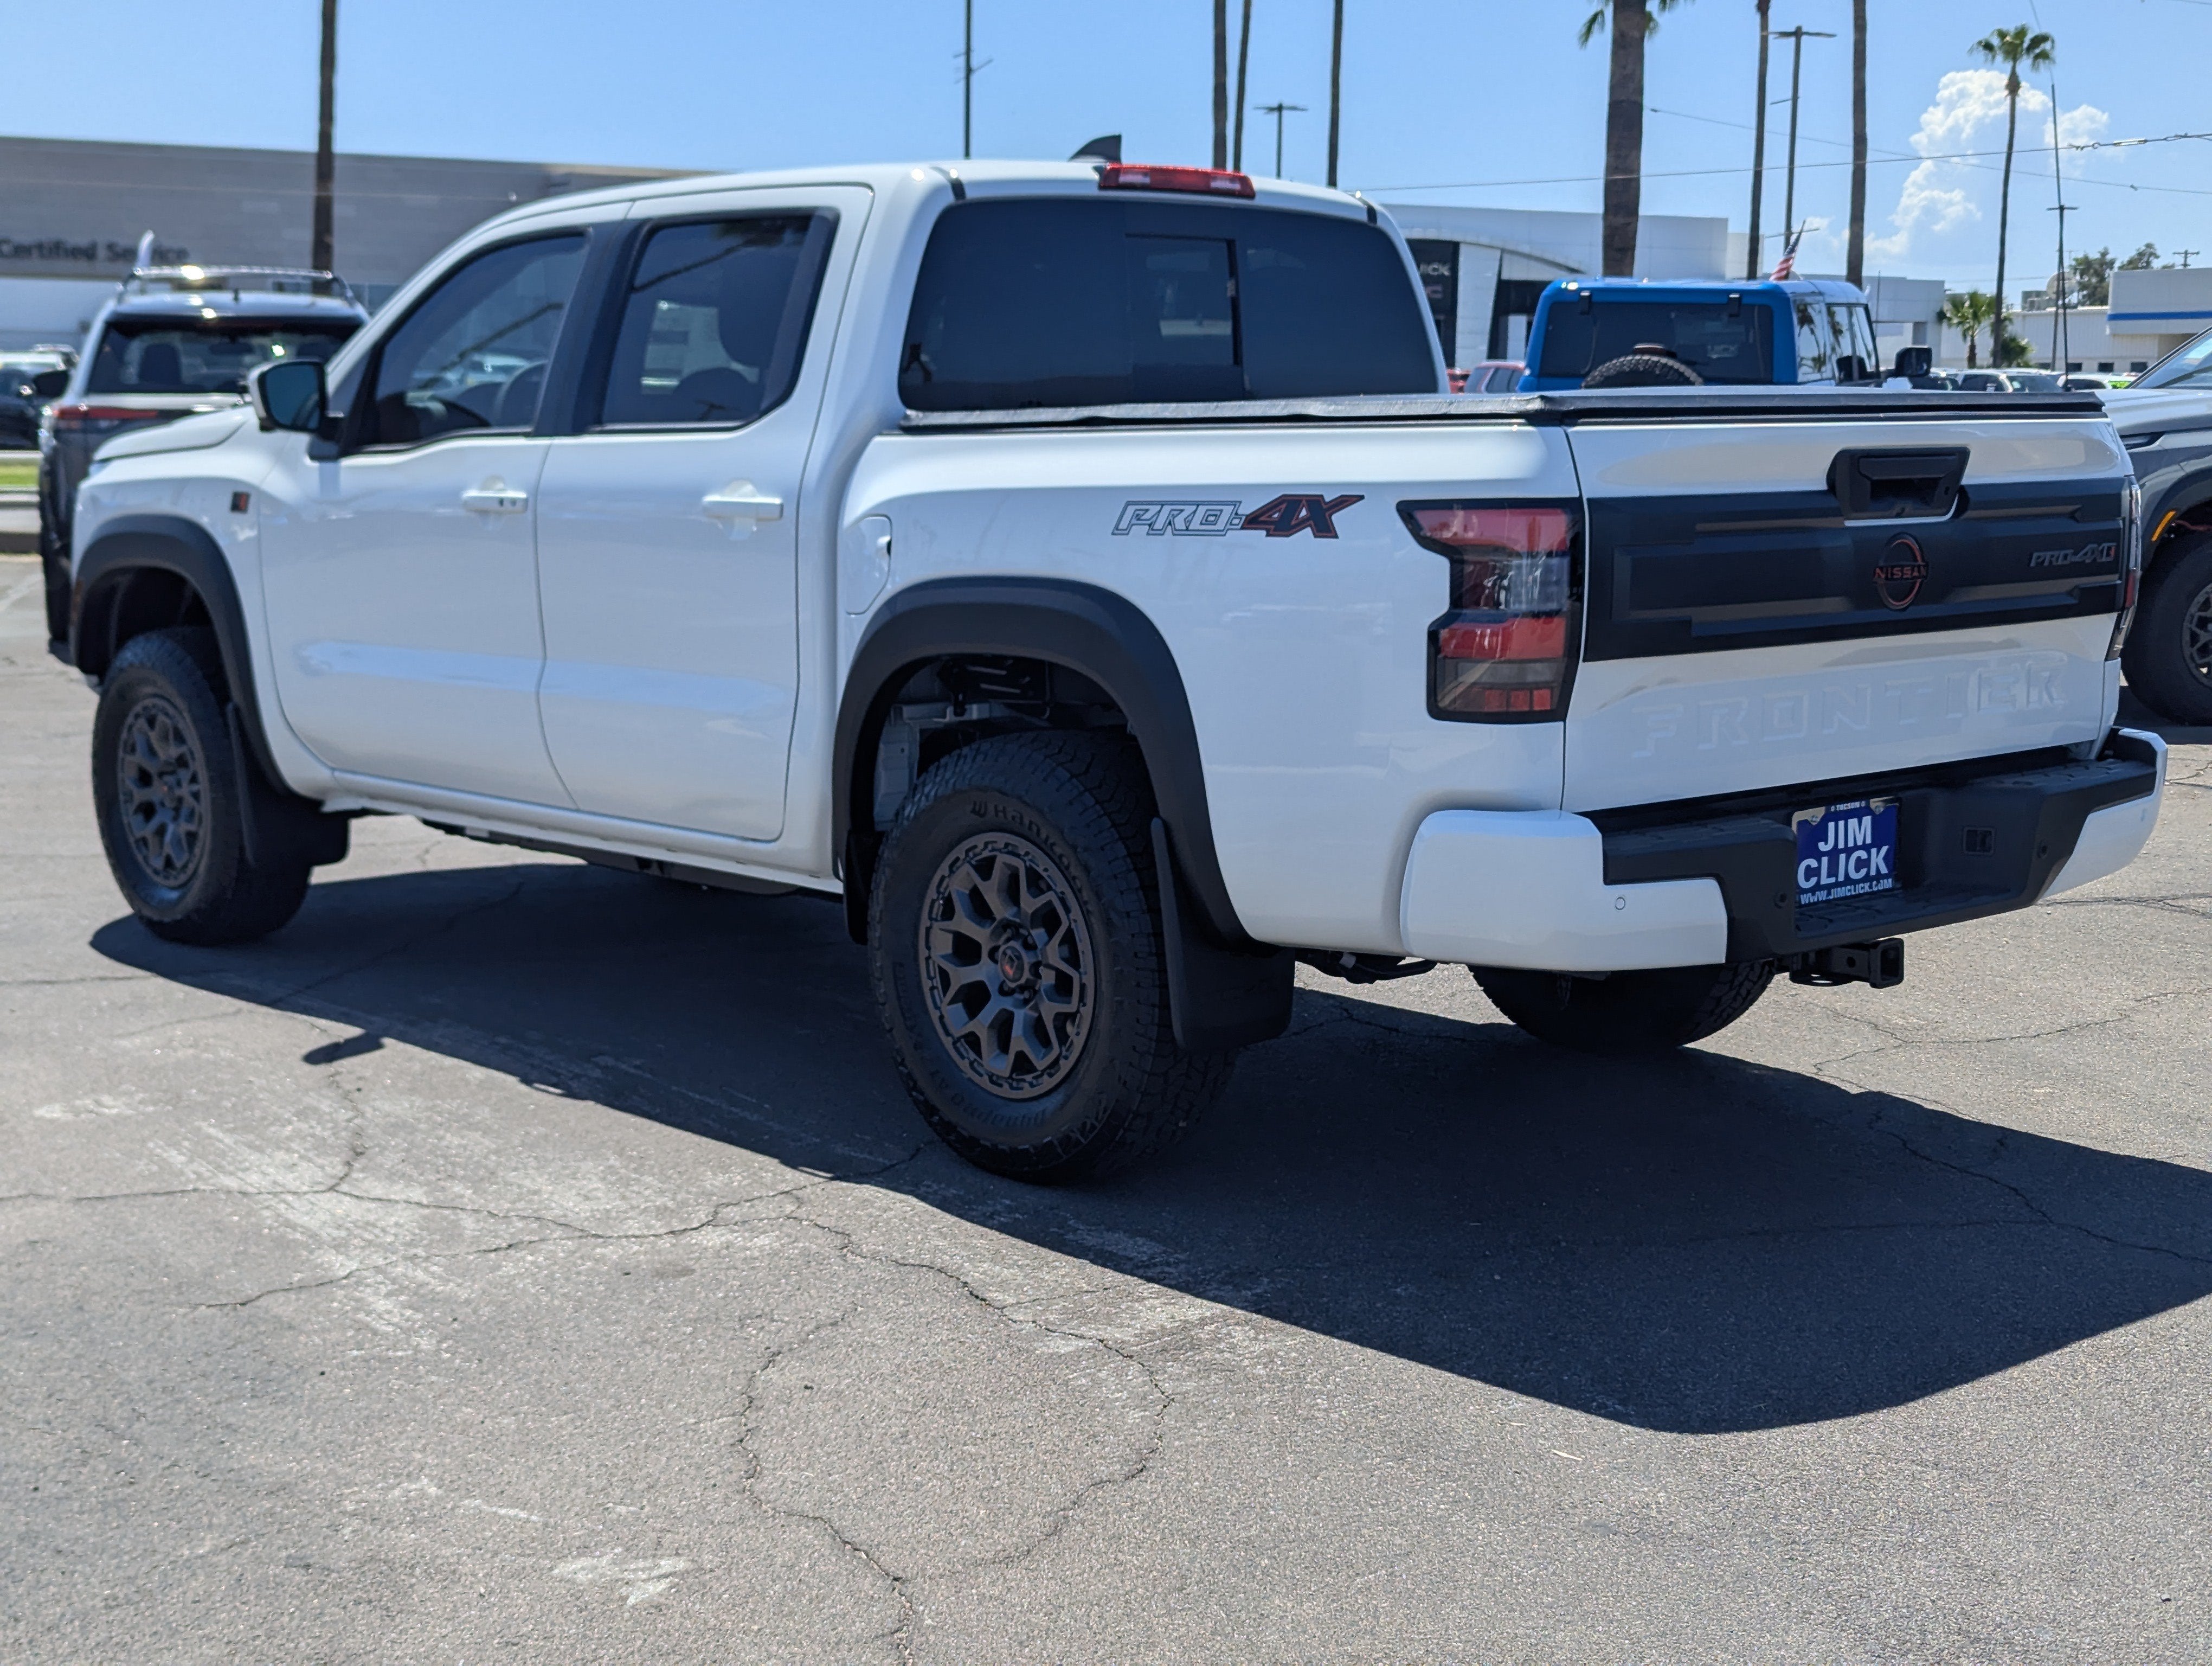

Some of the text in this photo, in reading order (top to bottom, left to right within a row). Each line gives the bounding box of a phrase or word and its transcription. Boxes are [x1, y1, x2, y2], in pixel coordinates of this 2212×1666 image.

[0, 239, 189, 261] Certified Serice
[1874, 566, 1927, 579] NISSAN
[1630, 659, 2067, 758] FRONTIER
[1818, 815, 1872, 851] JIM
[1797, 845, 1889, 889] CLICK
